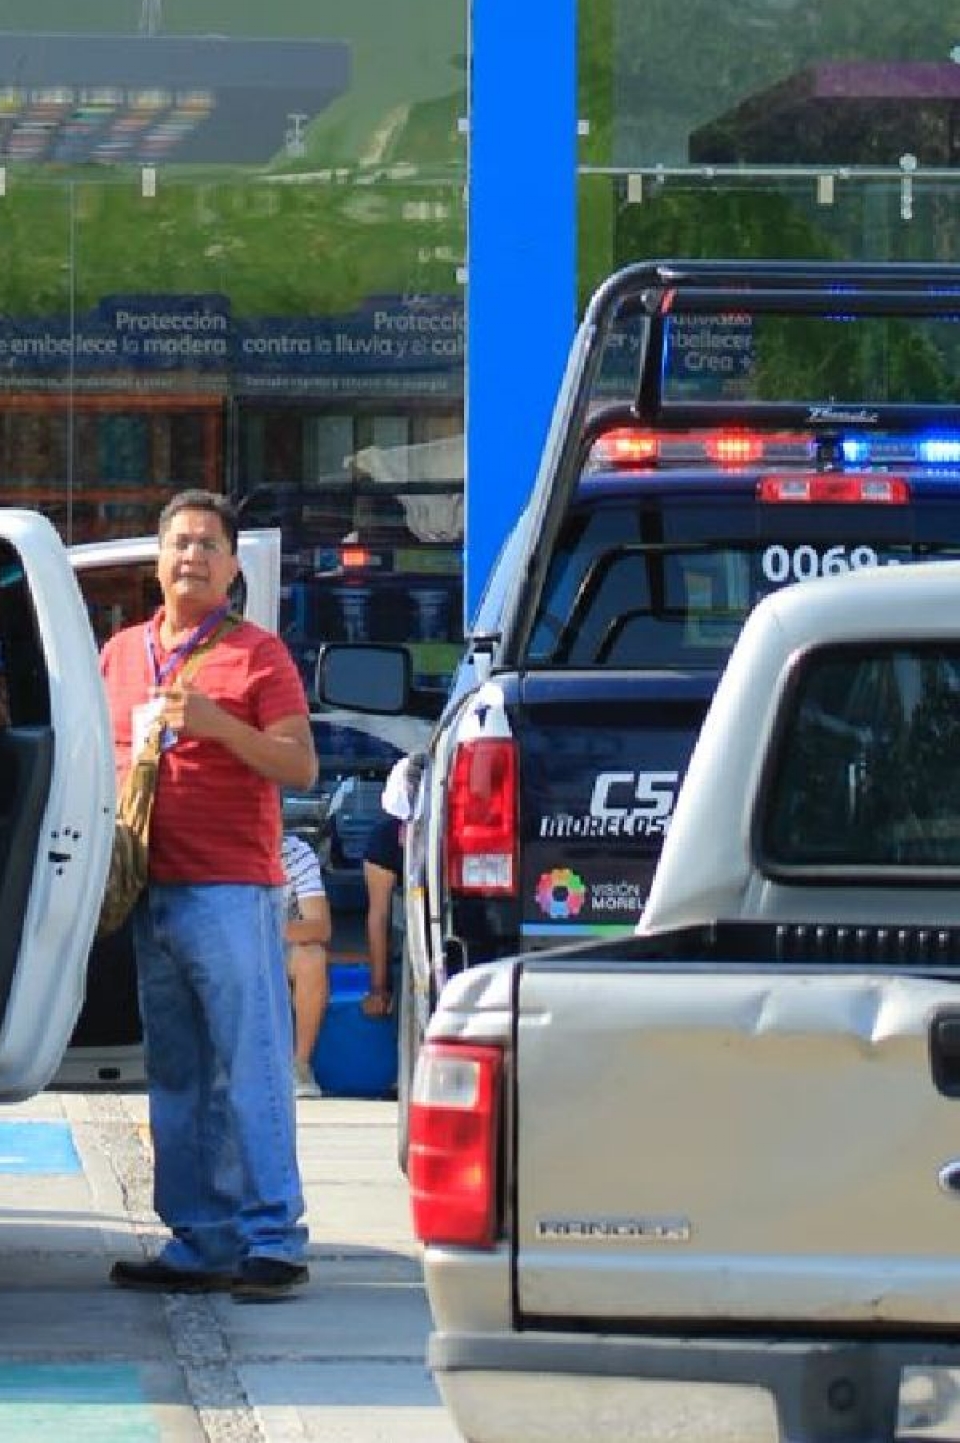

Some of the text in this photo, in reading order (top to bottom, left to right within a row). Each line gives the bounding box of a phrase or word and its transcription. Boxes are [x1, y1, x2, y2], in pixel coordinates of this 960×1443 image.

[116, 309, 227, 330] Protección
[10, 333, 118, 355] embellece
[123, 335, 141, 354] la
[144, 333, 227, 355] madera
[242, 334, 311, 354] contra
[315, 334, 332, 354] la
[336, 333, 391, 355] lluvia
